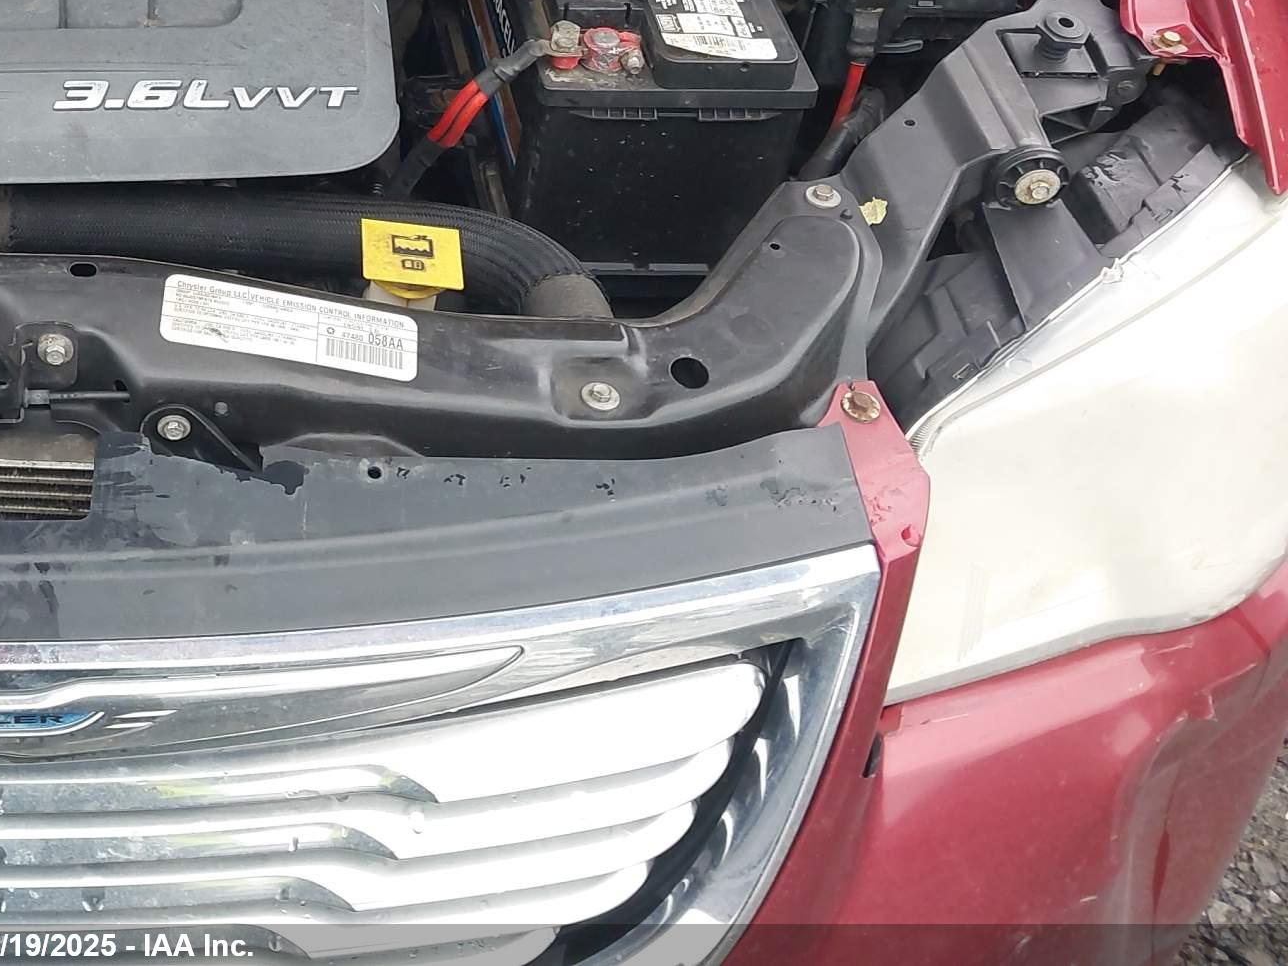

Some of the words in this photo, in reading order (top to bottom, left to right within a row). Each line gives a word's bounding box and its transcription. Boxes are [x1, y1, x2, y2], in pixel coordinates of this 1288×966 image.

[53, 80, 230, 110] 3.6L
[232, 86, 360, 110] VVT
[177, 280, 207, 291] Chrysler
[209, 285, 232, 297] Group
[234, 290, 247, 299] LLC
[251, 293, 280, 305] VEHICLE
[282, 299, 317, 312] EMISSION
[319, 306, 351, 318] CONTROL
[353, 313, 404, 328] INFORMATION
